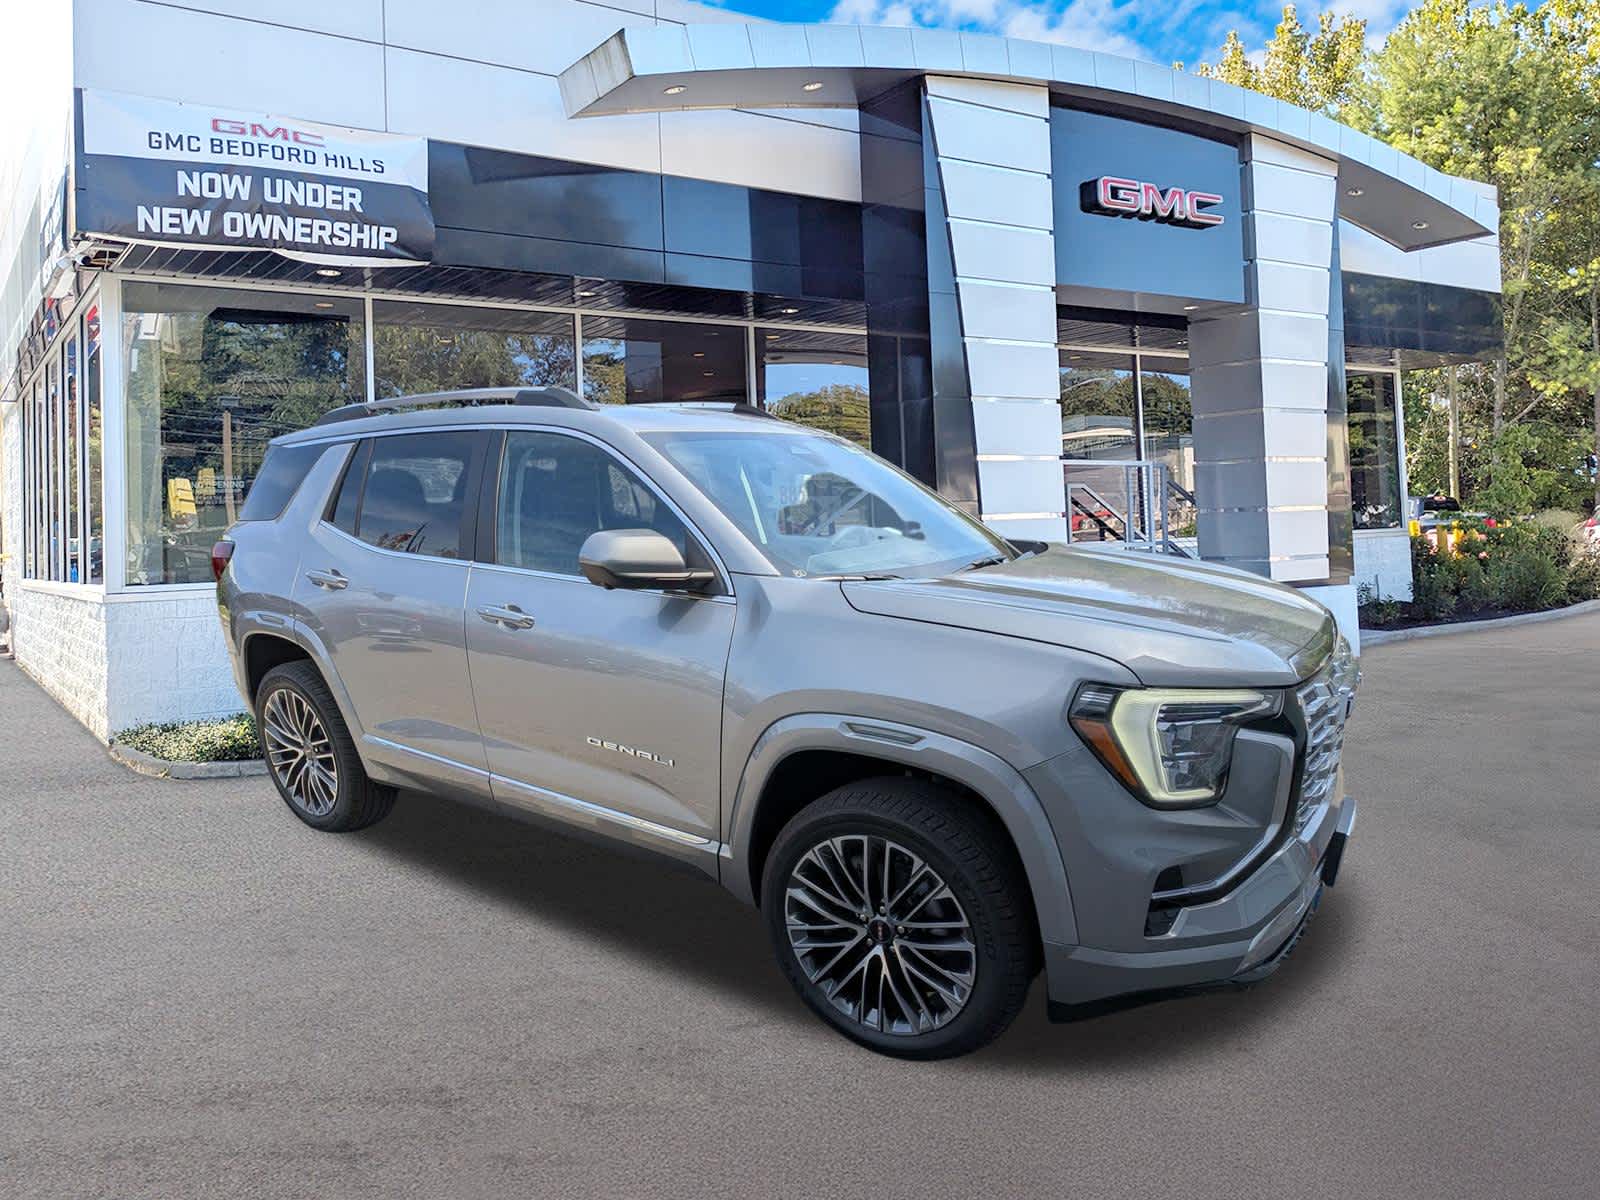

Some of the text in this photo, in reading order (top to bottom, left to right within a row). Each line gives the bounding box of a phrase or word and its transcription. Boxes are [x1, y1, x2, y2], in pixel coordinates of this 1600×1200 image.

[148, 131, 385, 174] GMC BEDFORD HILLS
[211, 118, 325, 147] GMC
[177, 170, 364, 213] NOW UNDER
[1097, 175, 1225, 225] GMC
[136, 205, 398, 251] NEW OWNERSHIP
[586, 737, 675, 768] DENALI
